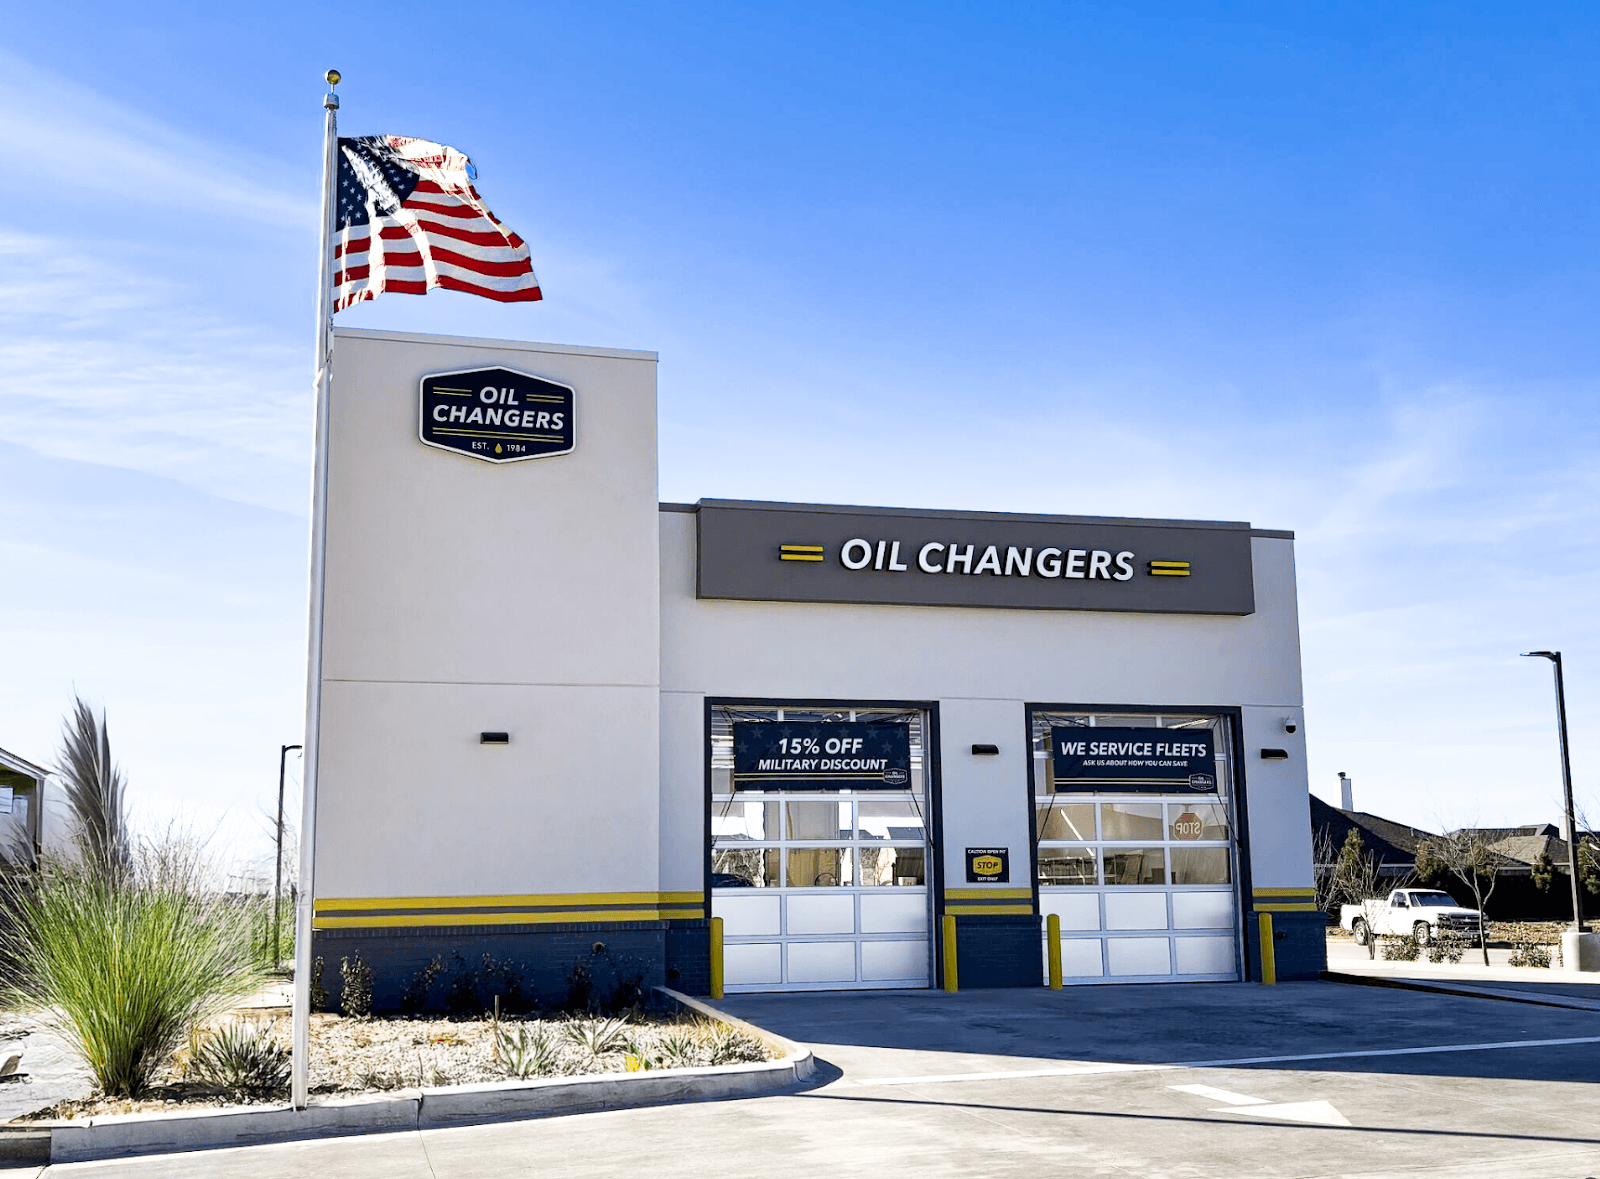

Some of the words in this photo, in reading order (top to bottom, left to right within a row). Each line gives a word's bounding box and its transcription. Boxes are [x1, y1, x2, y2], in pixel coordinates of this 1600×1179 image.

[479, 386, 519, 405] OIL
[432, 404, 564, 430] CHANGERS
[471, 441, 490, 450] EST.
[506, 444, 526, 453] 1984
[840, 537, 909, 572] OIL
[917, 541, 1136, 582] CHANGERS
[778, 737, 821, 755] 15%
[824, 737, 864, 755] OFF
[1061, 741, 1087, 757] WE
[1089, 741, 1153, 757] SERVICE
[1156, 742, 1208, 758] FLEETS
[757, 758, 819, 771] MILITARY
[820, 758, 889, 771] DISCOUNT
[1172, 760, 1189, 768] SAVE
[977, 861, 999, 869] STOP
